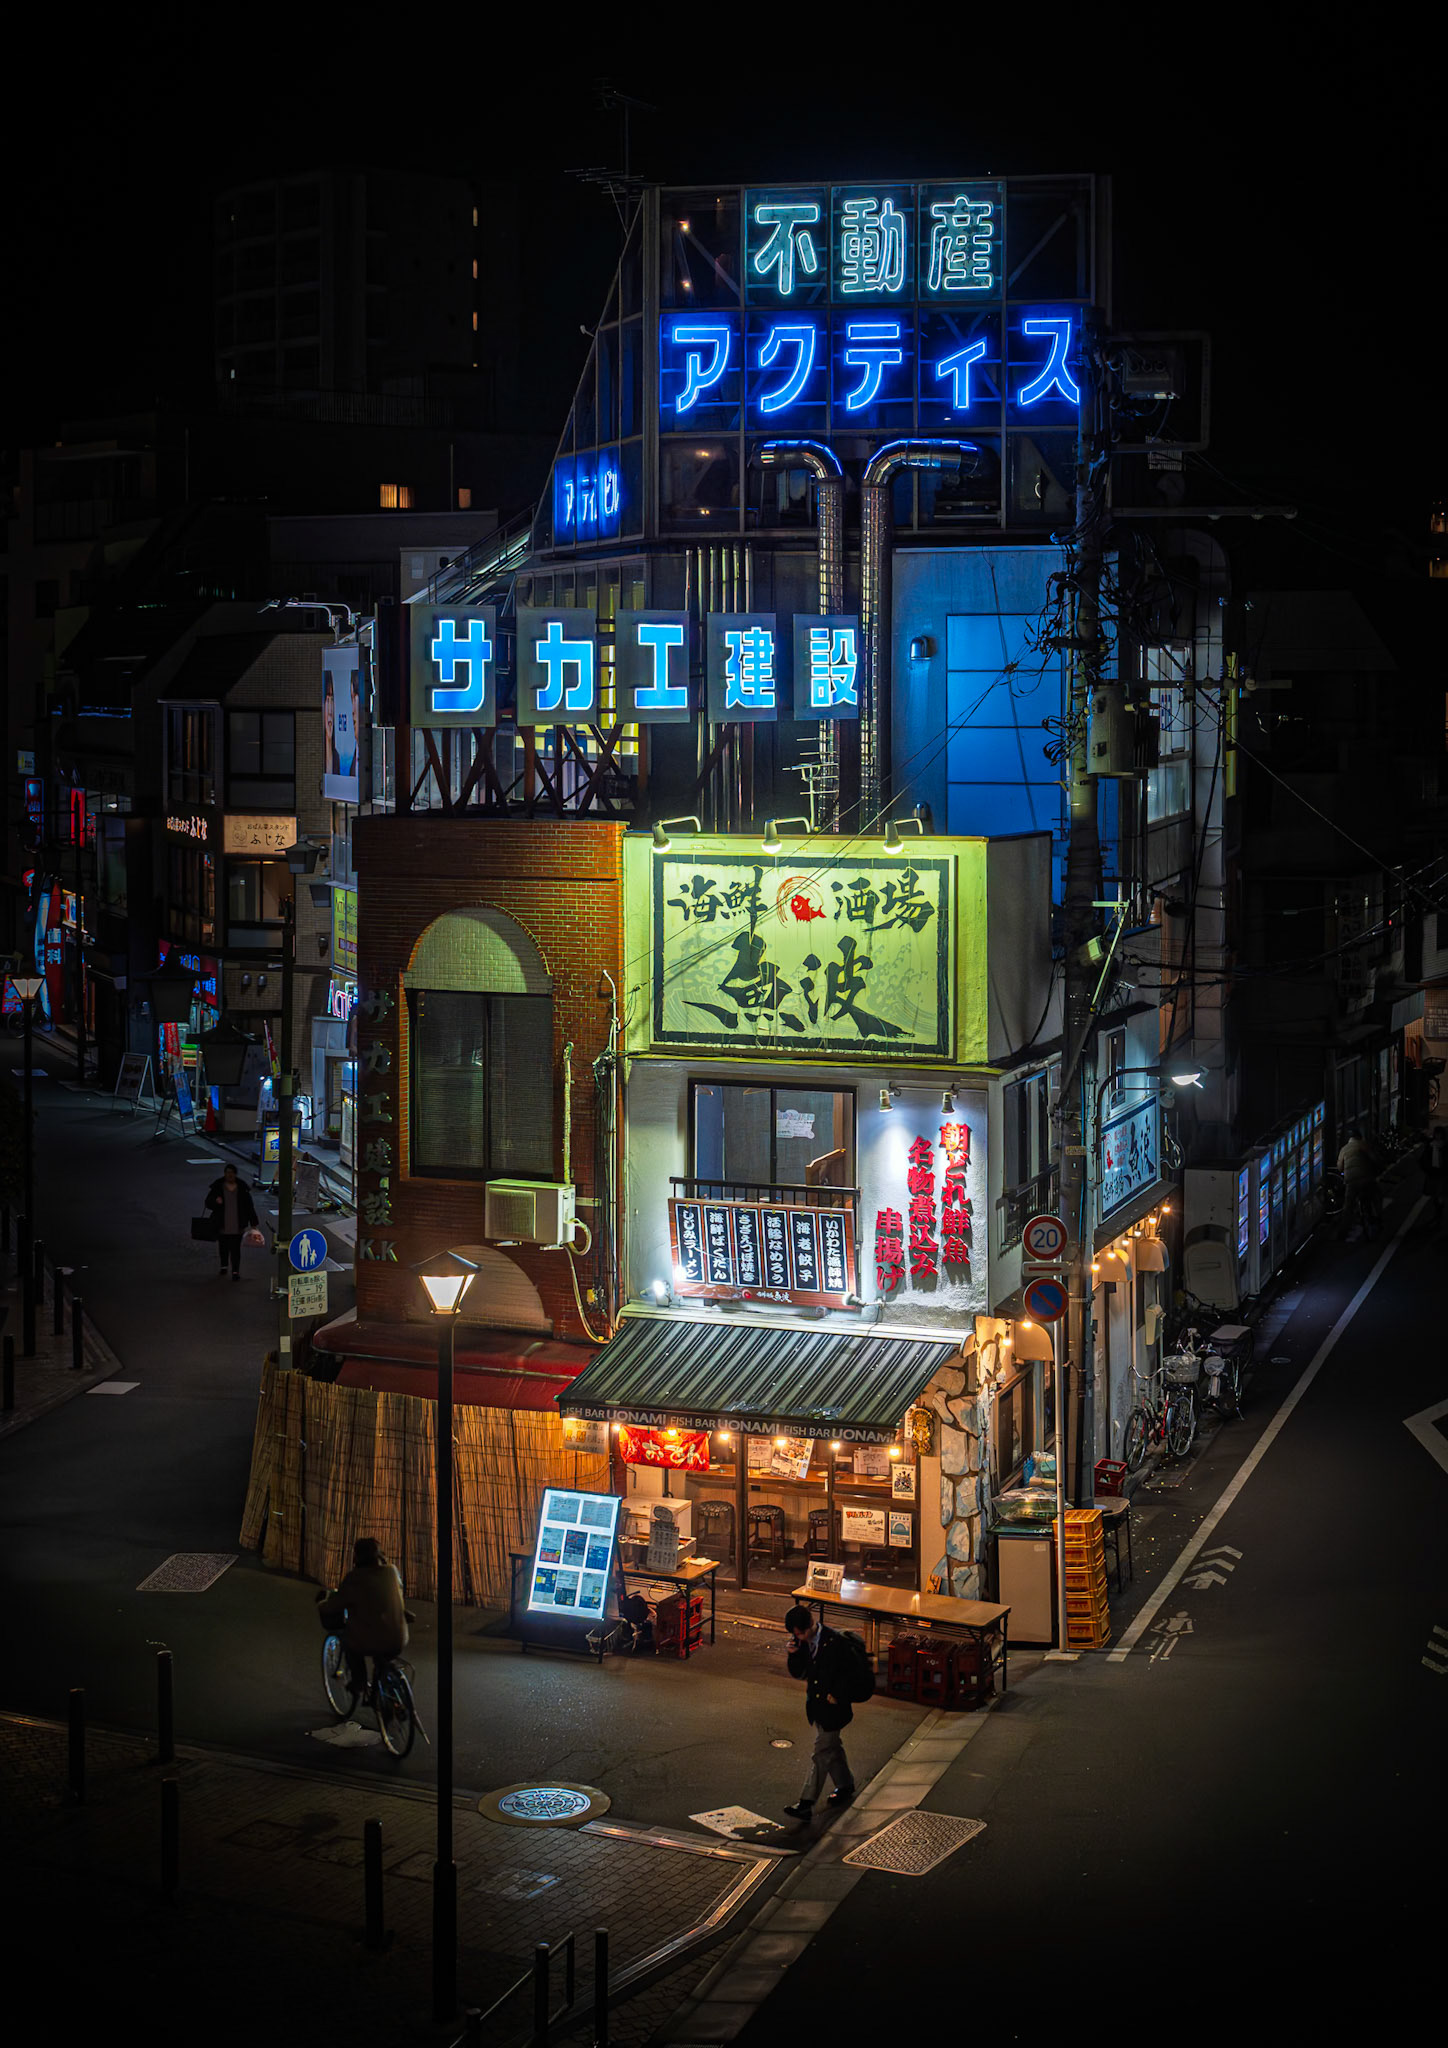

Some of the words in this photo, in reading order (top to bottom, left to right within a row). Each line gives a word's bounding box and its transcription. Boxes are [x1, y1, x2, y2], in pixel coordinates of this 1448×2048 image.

[755, 194, 993, 294] 不動産
[672, 317, 1080, 413] アクティス
[250, 833, 285, 846] ふじな
[667, 865, 768, 936] 海鮮
[831, 866, 935, 933] 酒場
[682, 931, 917, 1039] 魚波
[907, 1135, 938, 1279] 名物煮込み
[939, 1122, 971, 1264] 朝どれ鮮魚
[682, 1210, 699, 1278] しじみラーメン
[709, 1212, 727, 1280] 海鮮ばくだん
[796, 1221, 814, 1283] 海老餃子
[875, 1207, 905, 1293] 串揚げ
[1033, 1229, 1058, 1248] 20
[584, 1408, 605, 1419] BAR
[607, 1410, 666, 1425] UONAMI
[670, 1416, 693, 1427] FISH
[695, 1418, 716, 1429] BAR
[717, 1419, 780, 1435] UONAMI
[784, 1425, 807, 1436] FISH
[809, 1427, 831, 1438] BAR
[641, 1440, 706, 1465] おでん
